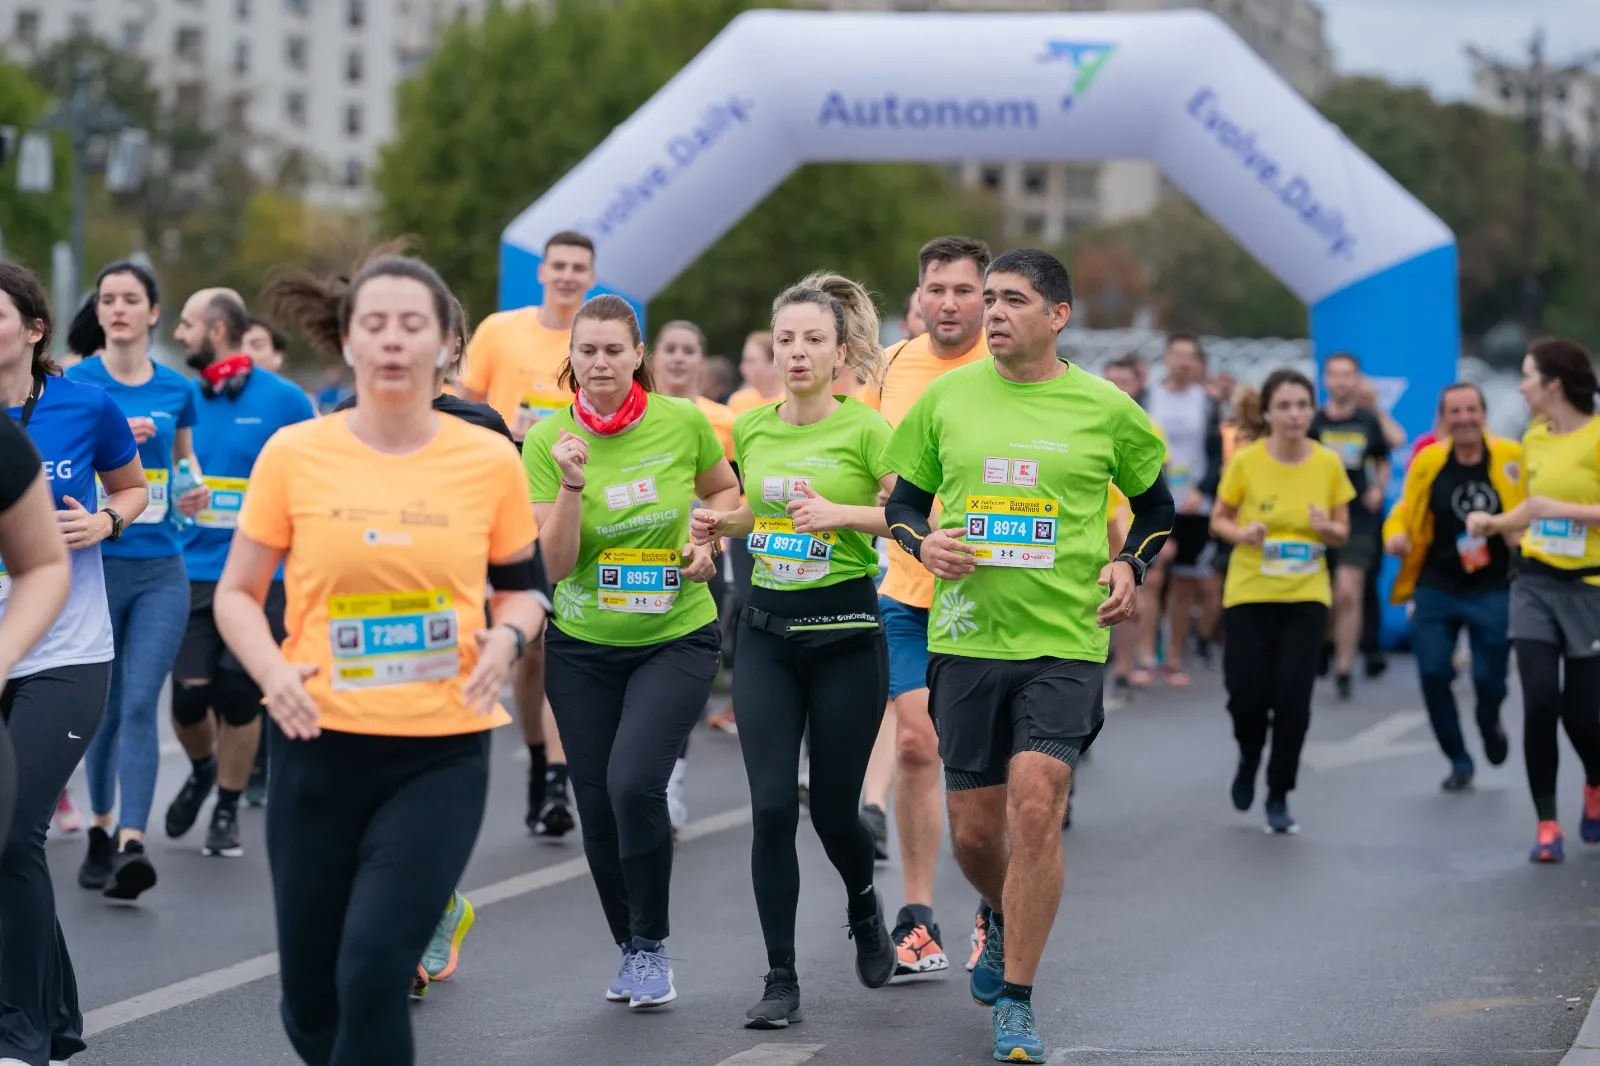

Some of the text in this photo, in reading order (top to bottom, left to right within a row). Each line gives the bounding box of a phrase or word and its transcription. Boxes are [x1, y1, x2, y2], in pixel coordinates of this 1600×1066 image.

[817, 91, 1039, 130] Autonom
[993, 520, 1027, 537] 8974
[773, 536, 804, 553] 8971
[626, 570, 658, 585] 8957
